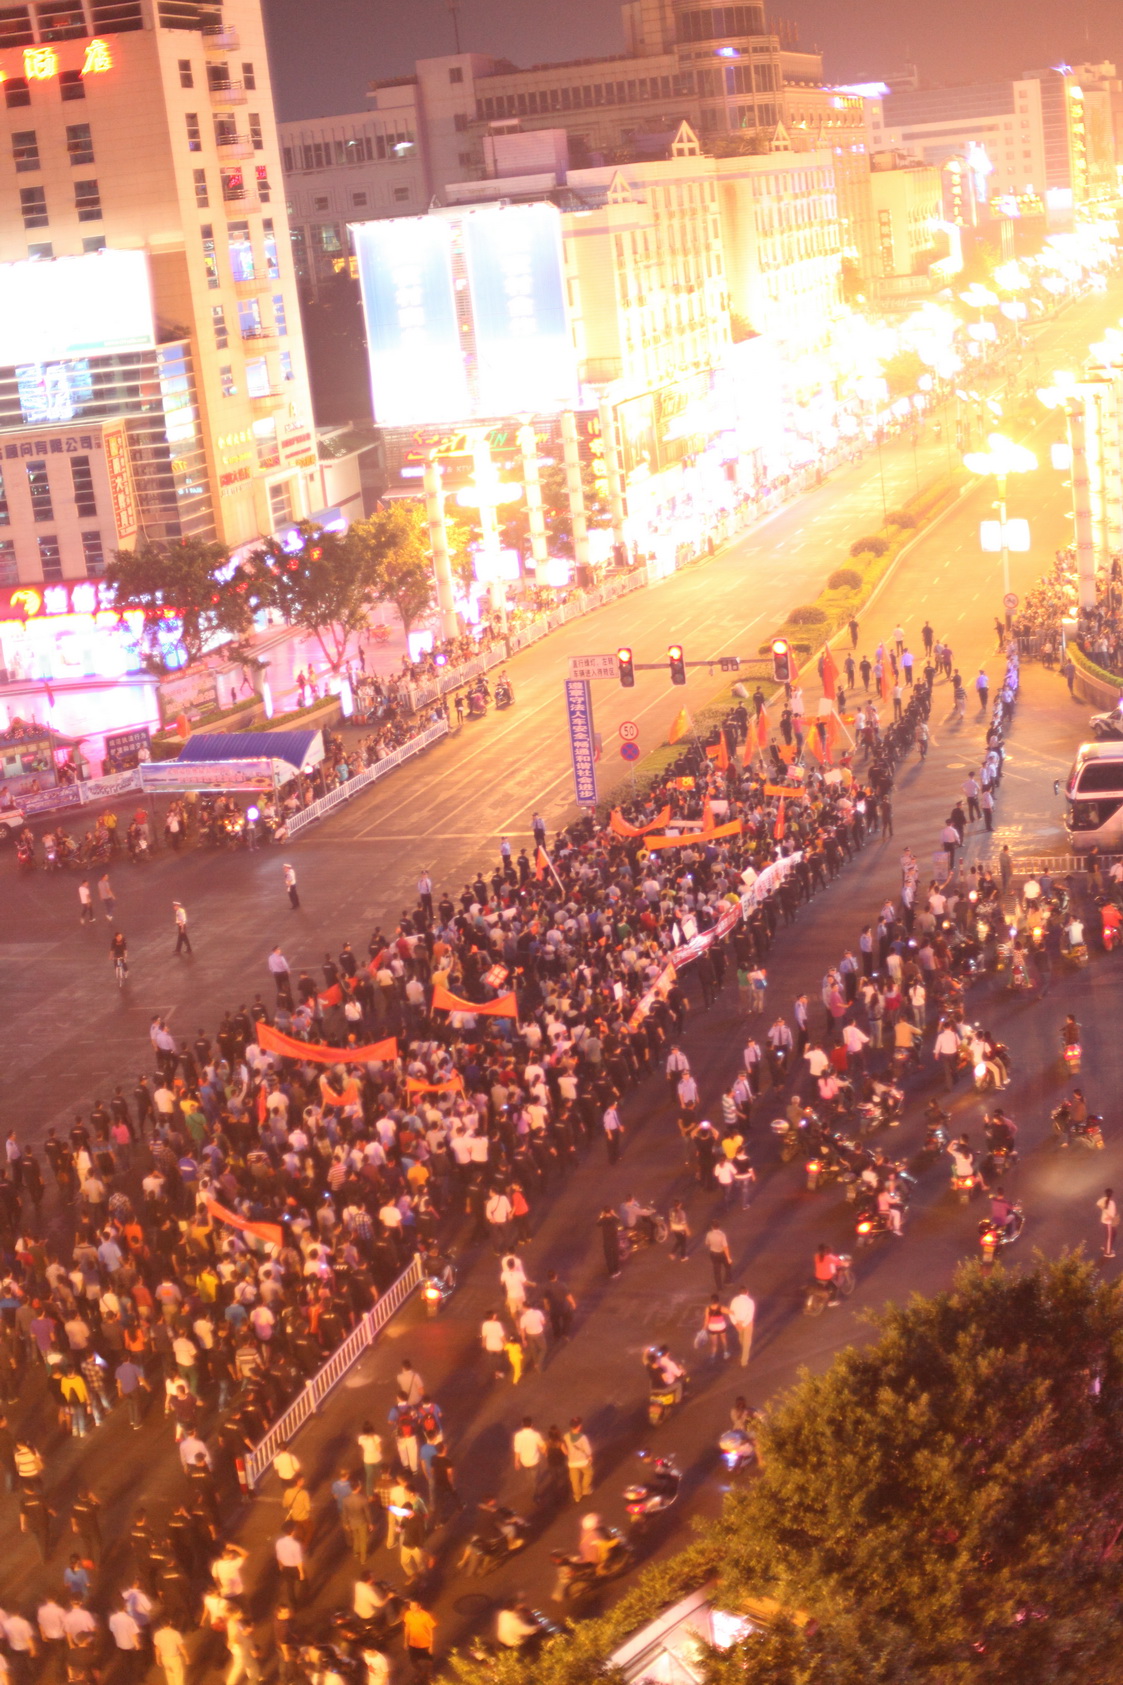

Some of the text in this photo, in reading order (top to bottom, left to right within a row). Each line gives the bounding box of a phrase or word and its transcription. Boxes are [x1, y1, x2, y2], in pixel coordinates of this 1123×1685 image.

[0, 435, 93, 460] 顾问有限公司
[623, 725, 634, 737] 50
